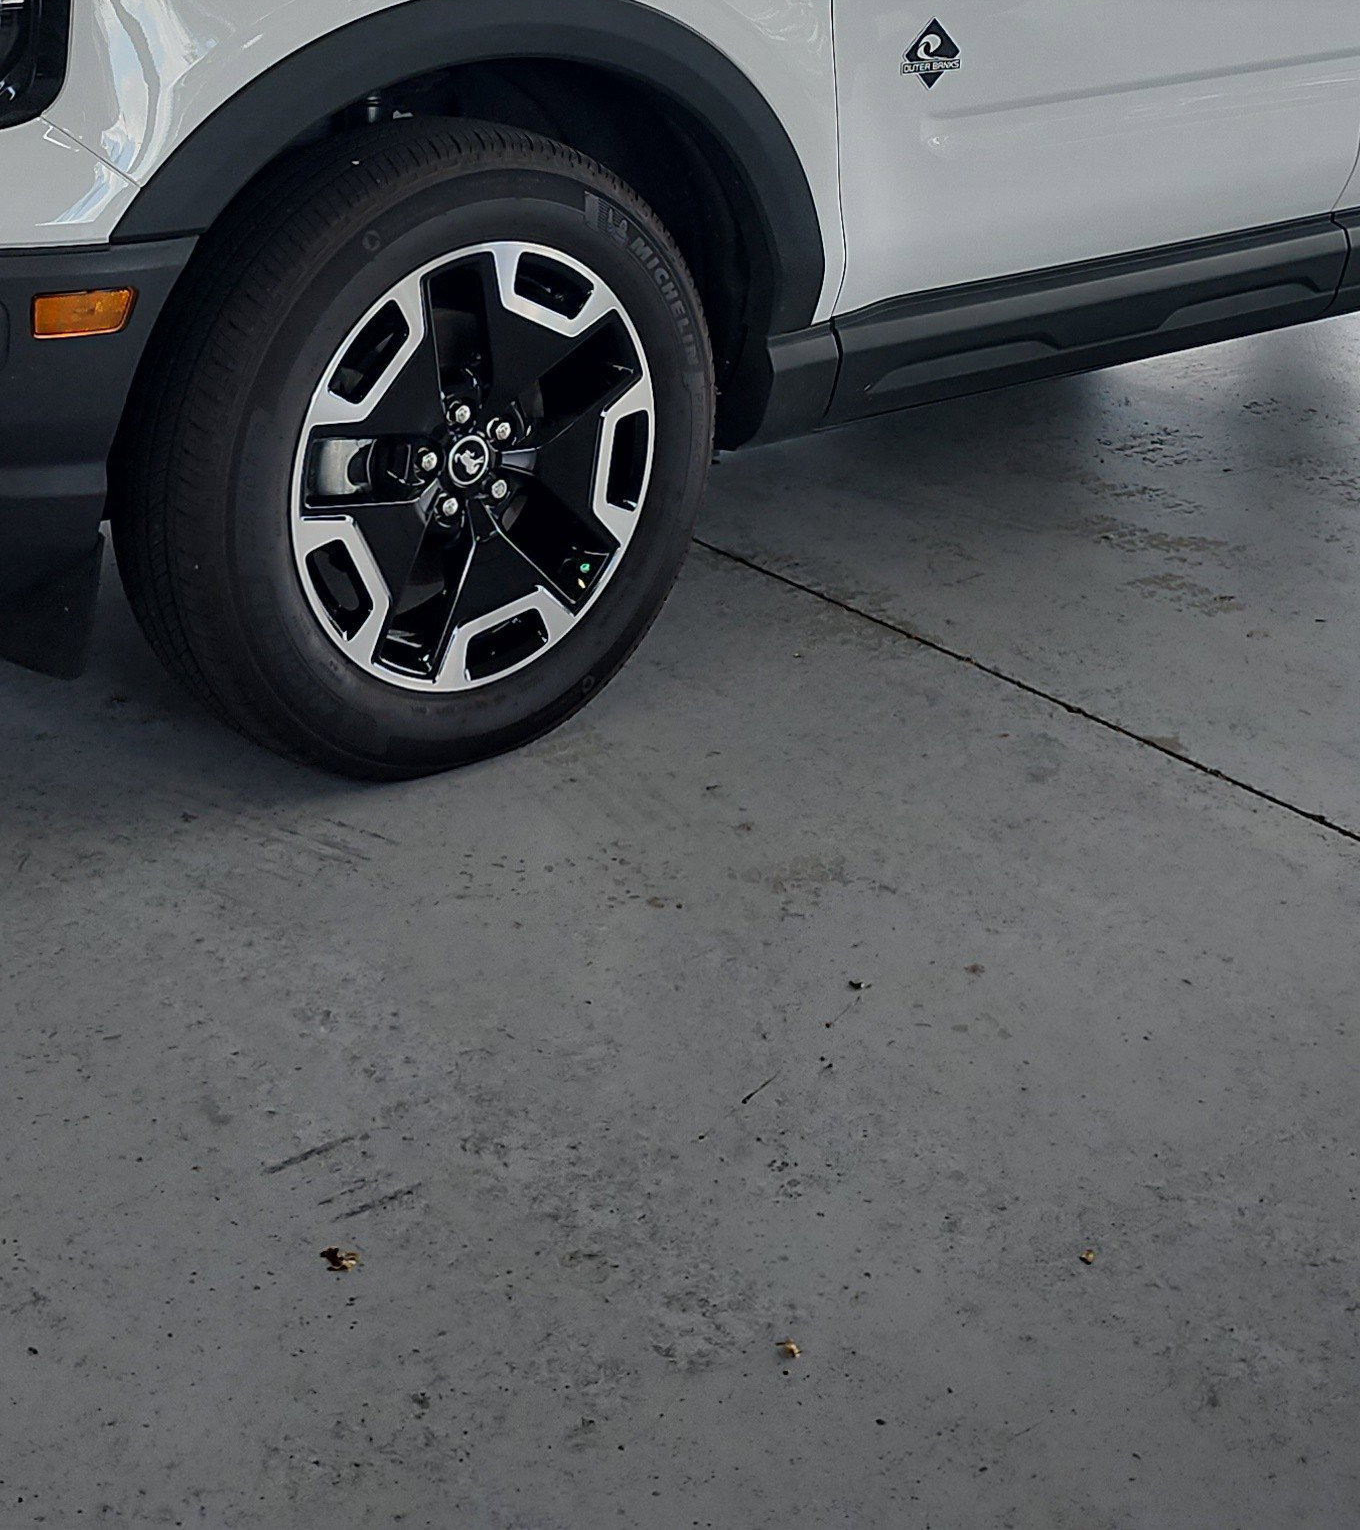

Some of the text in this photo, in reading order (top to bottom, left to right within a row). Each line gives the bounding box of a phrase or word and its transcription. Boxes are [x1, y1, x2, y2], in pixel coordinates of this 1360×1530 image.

[903, 60, 960, 73] OUTER BANKS
[630, 236, 699, 364] MICHELIN
